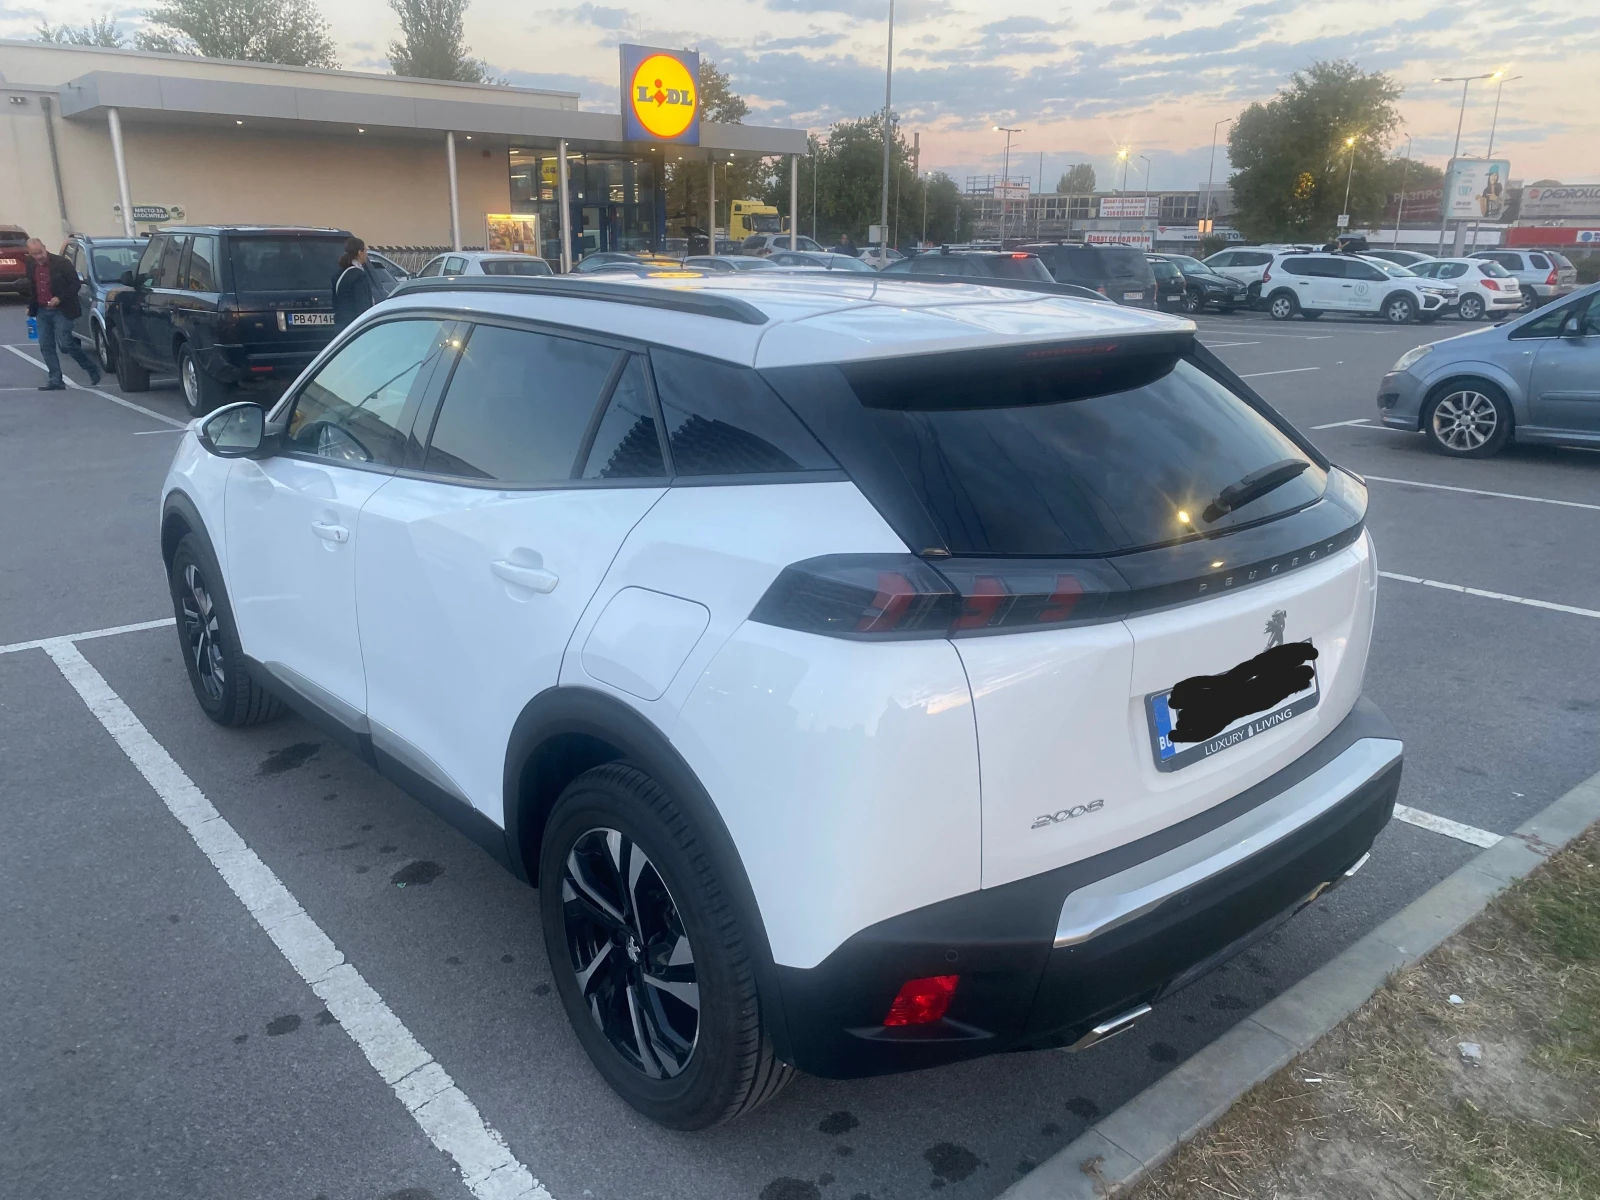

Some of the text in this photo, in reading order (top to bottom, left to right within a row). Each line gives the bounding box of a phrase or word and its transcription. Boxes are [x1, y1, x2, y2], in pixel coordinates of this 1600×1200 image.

[1393, 189, 1443, 203] РАЗПРО
[1087, 234, 1108, 242] Дават
[307, 314, 327, 324] 4714
[1198, 543, 1334, 592] PEUGEOT
[1204, 708, 1293, 756] LUXURY LIVING
[1031, 799, 1105, 829] 2008
